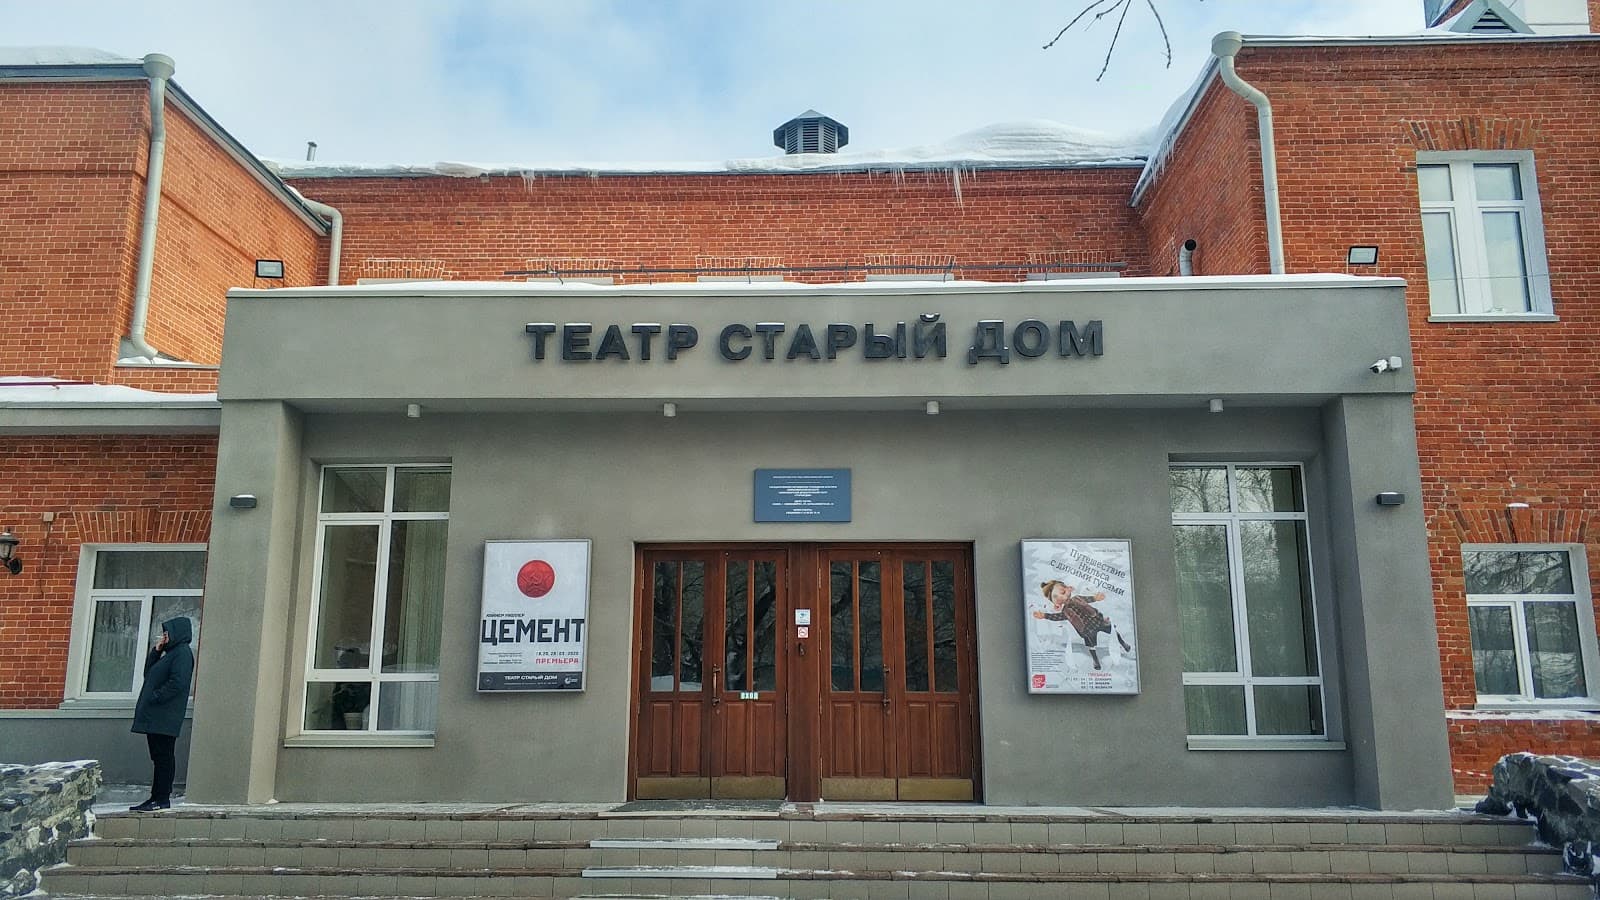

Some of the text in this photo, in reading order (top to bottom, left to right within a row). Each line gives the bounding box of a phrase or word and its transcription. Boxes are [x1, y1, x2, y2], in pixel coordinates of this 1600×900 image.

[525, 312, 1105, 365] ТЕАТР СТАРЫЙ ДОМ
[1070, 548, 1126, 579] Путешествие
[1078, 562, 1110, 582] Нильса
[1056, 561, 1092, 582] дикими
[1093, 577, 1125, 596] гусями
[481, 618, 584, 646] ЦЕМЕНТ
[535, 657, 579, 665] ПРЕМЬЕРА
